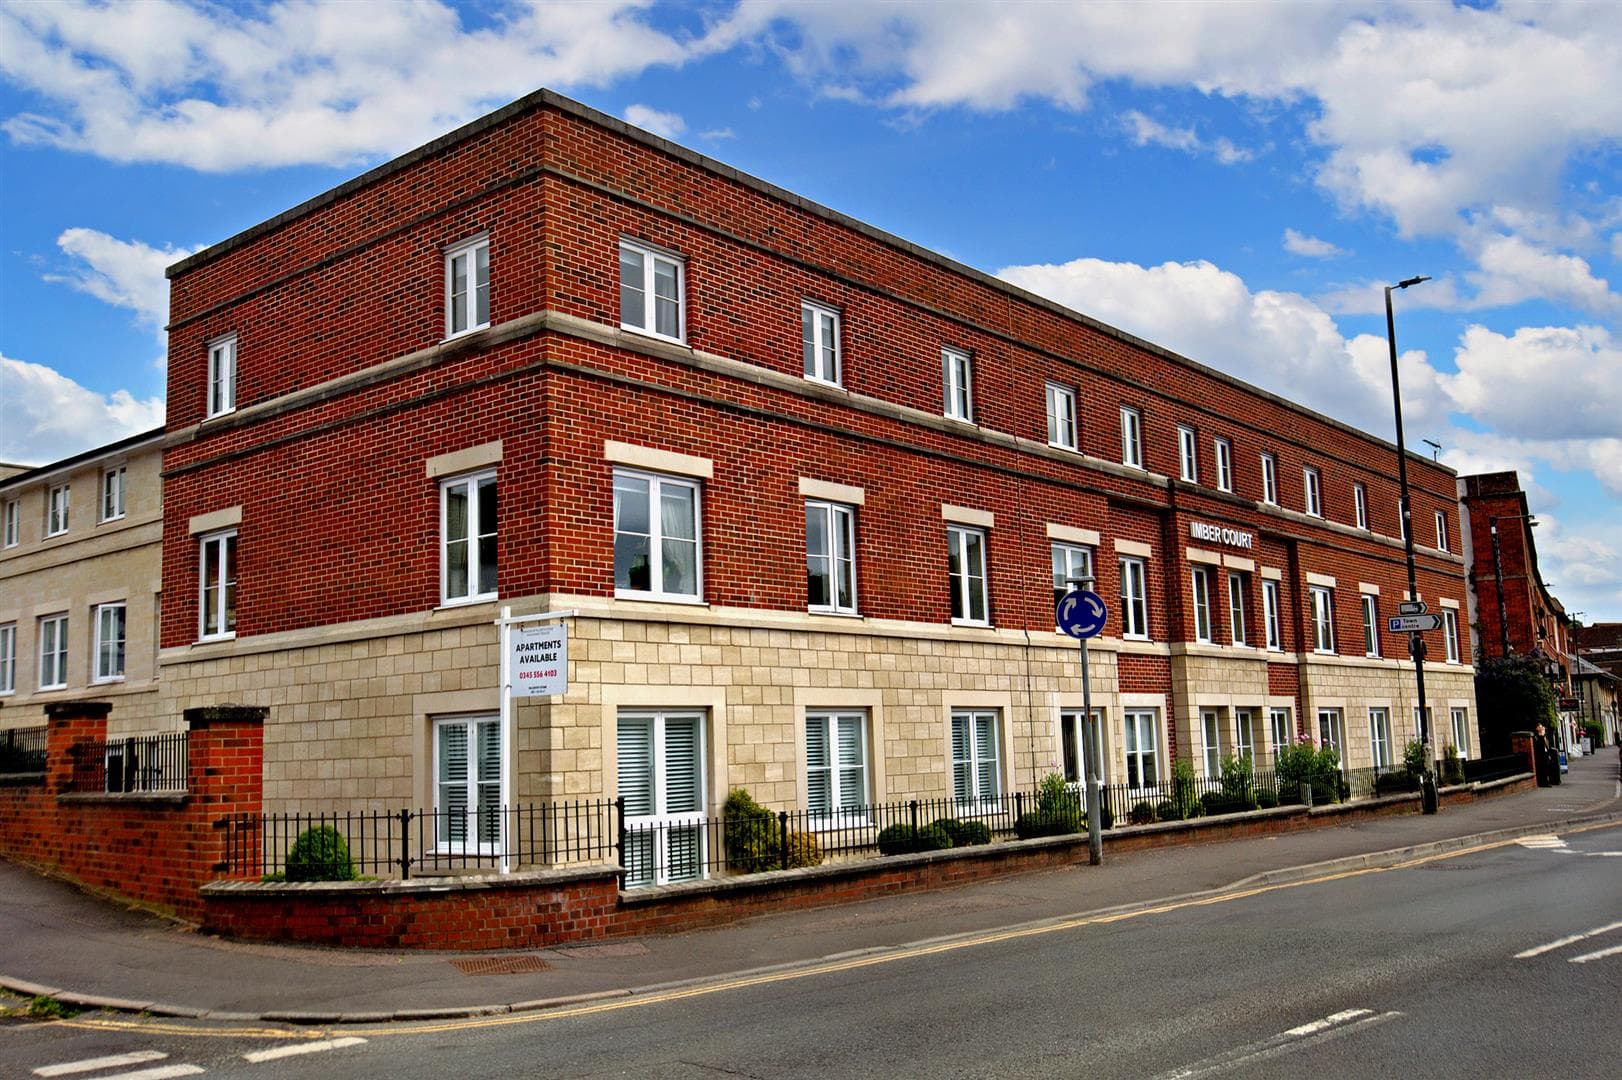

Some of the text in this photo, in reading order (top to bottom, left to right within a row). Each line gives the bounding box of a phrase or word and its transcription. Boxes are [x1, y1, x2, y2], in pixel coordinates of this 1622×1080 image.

[1190, 522, 1252, 548] IMBER COURT
[516, 640, 561, 652] APARTMENTS
[520, 653, 557, 664] AVAILABLE
[533, 670, 543, 678] 556
